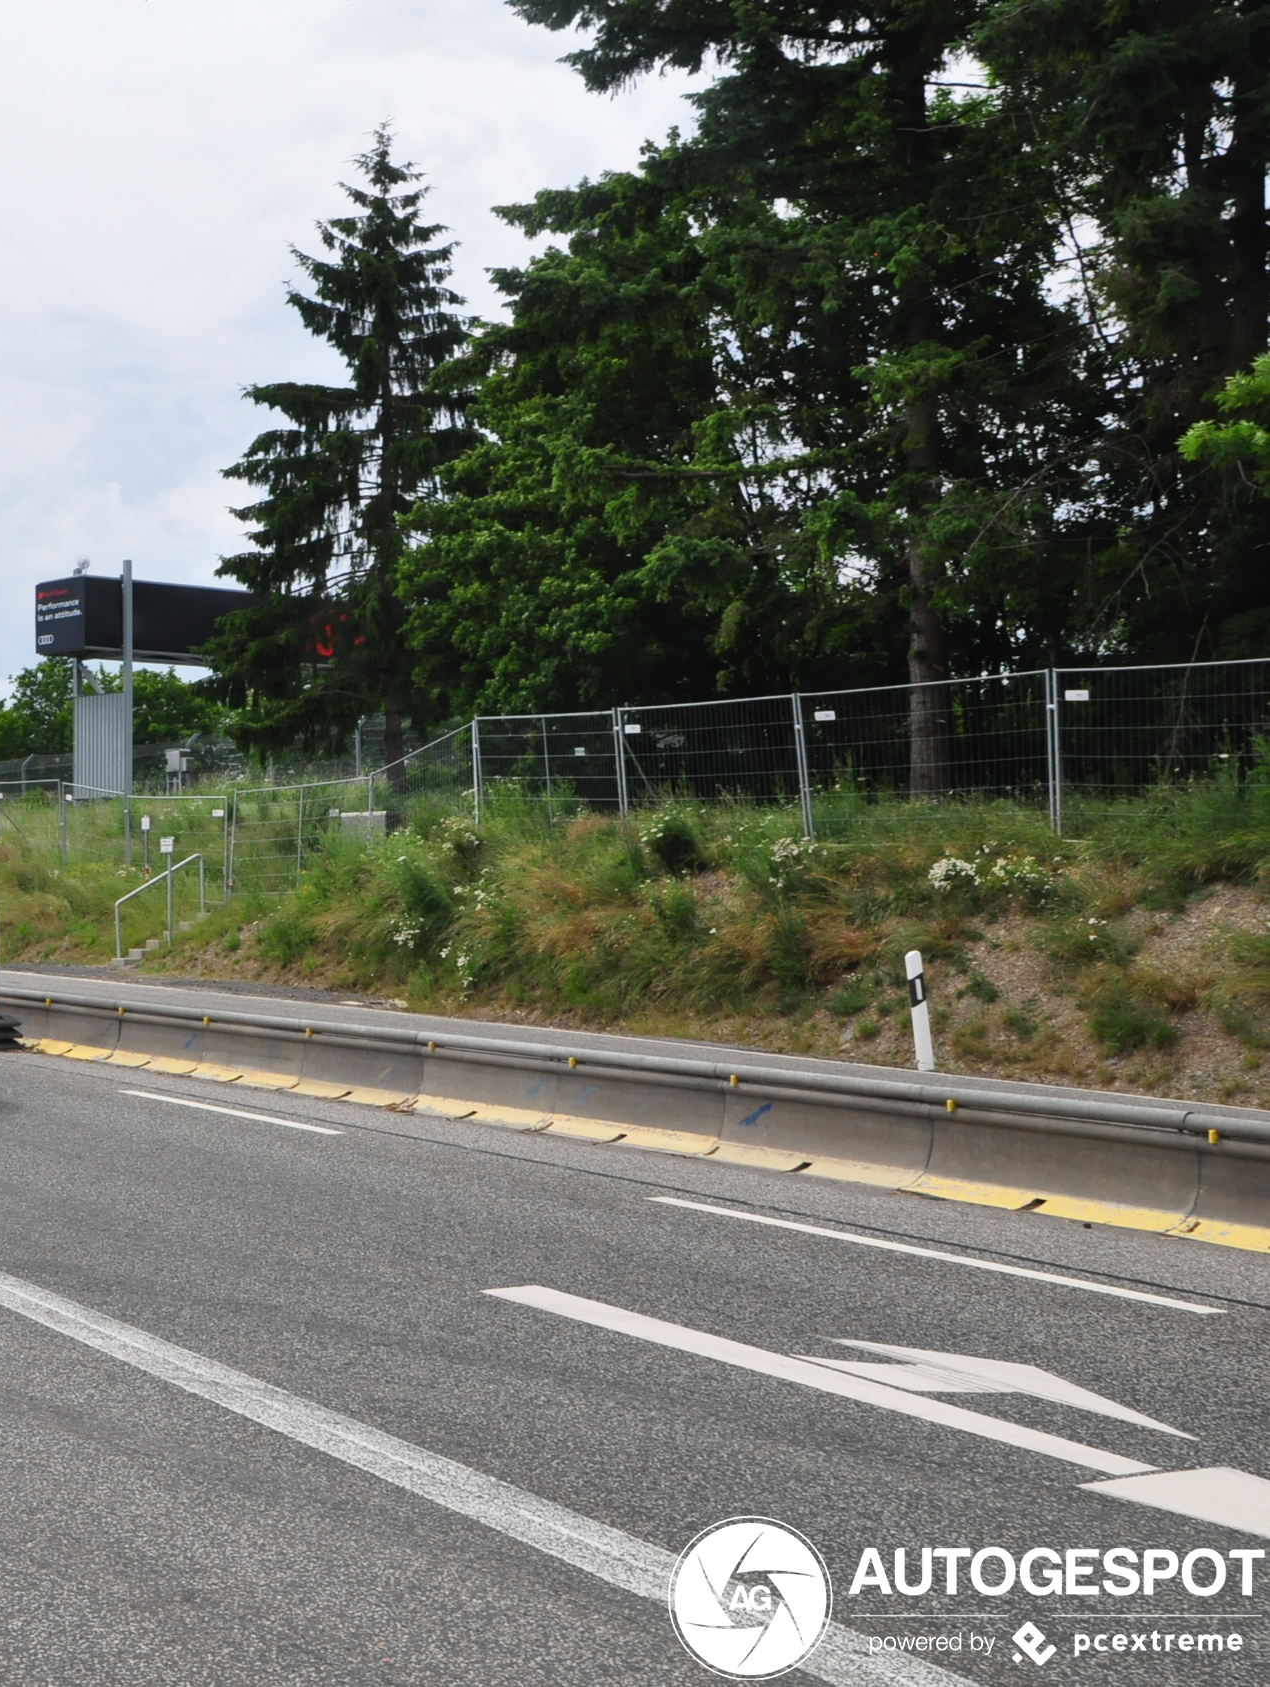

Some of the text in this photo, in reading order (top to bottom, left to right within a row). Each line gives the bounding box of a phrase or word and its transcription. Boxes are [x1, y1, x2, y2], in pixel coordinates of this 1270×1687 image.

[38, 599, 80, 611] Performance
[45, 613, 53, 621] an
[54, 609, 83, 619] attitude.
